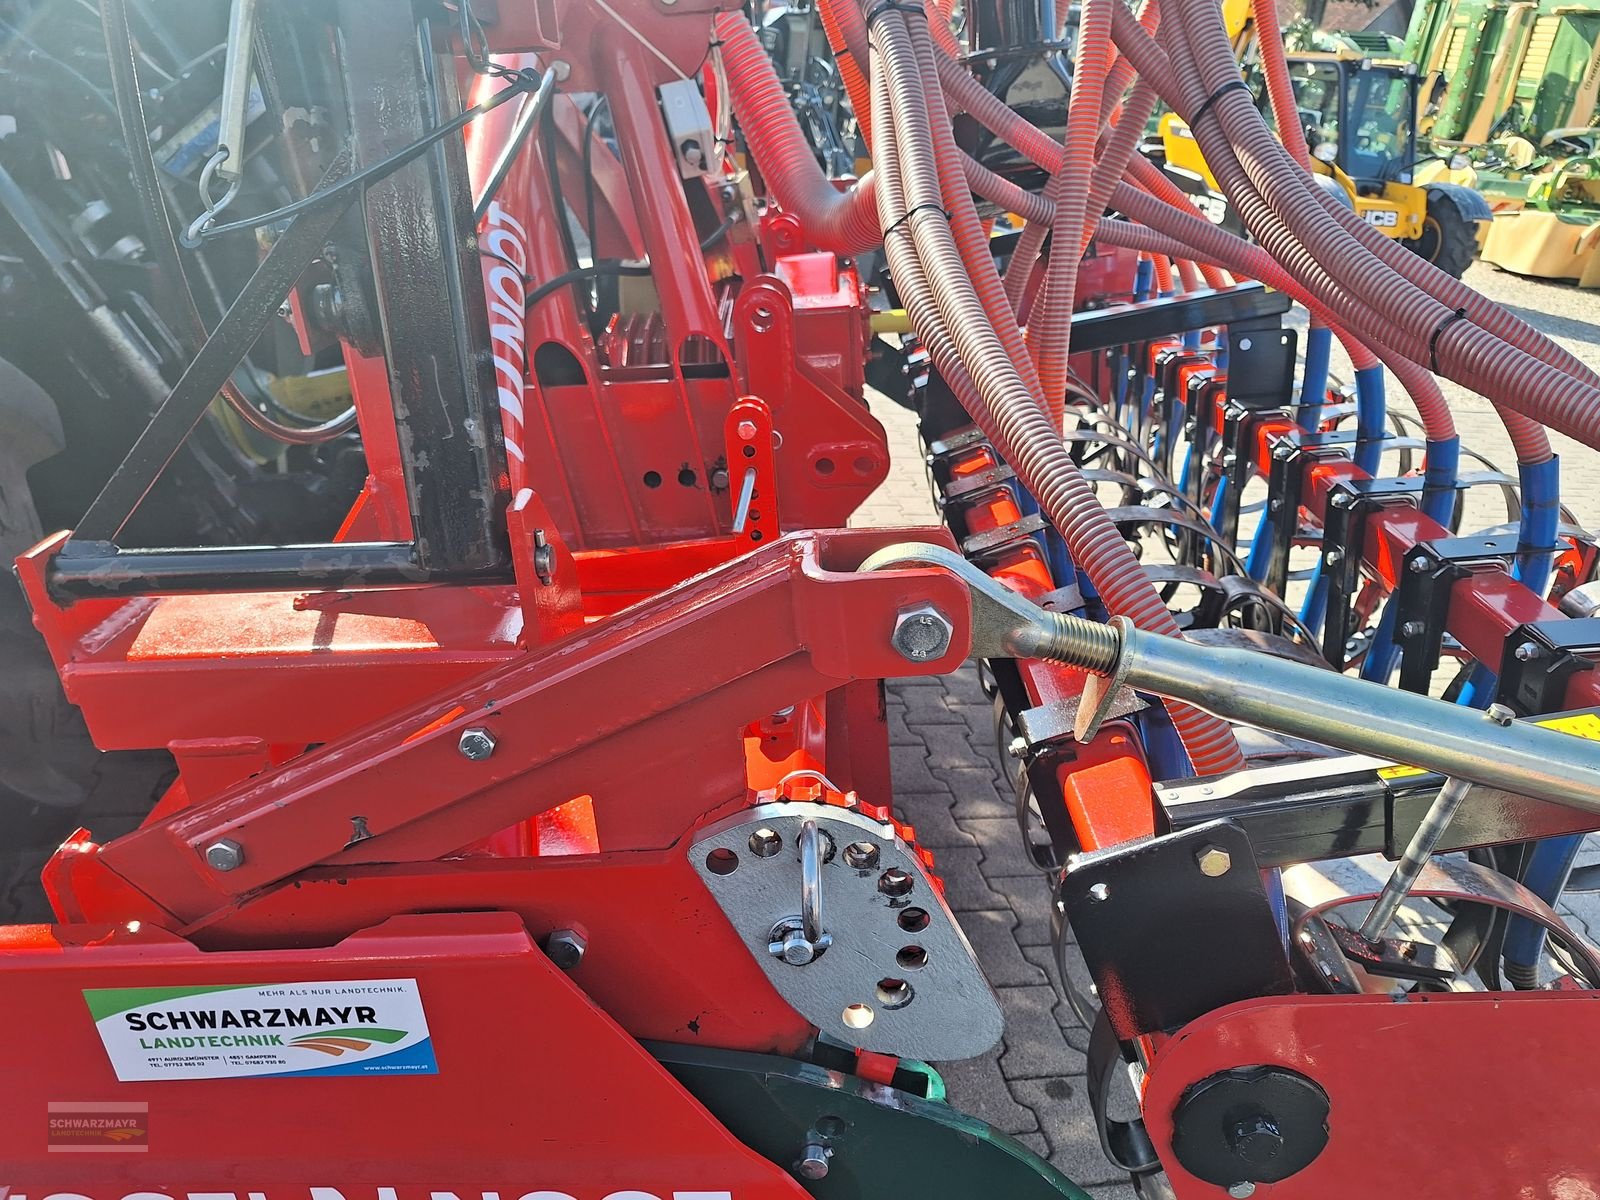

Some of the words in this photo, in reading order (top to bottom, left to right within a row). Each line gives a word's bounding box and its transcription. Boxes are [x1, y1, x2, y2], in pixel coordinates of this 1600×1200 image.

[1188, 193, 1227, 225] CB
[488, 201, 527, 362] NOOT
[335, 986, 407, 995] LANDTECHNIK.
[125, 1006, 378, 1032] SCHWARZMAYR
[139, 1034, 284, 1050] LANDTECHNIK
